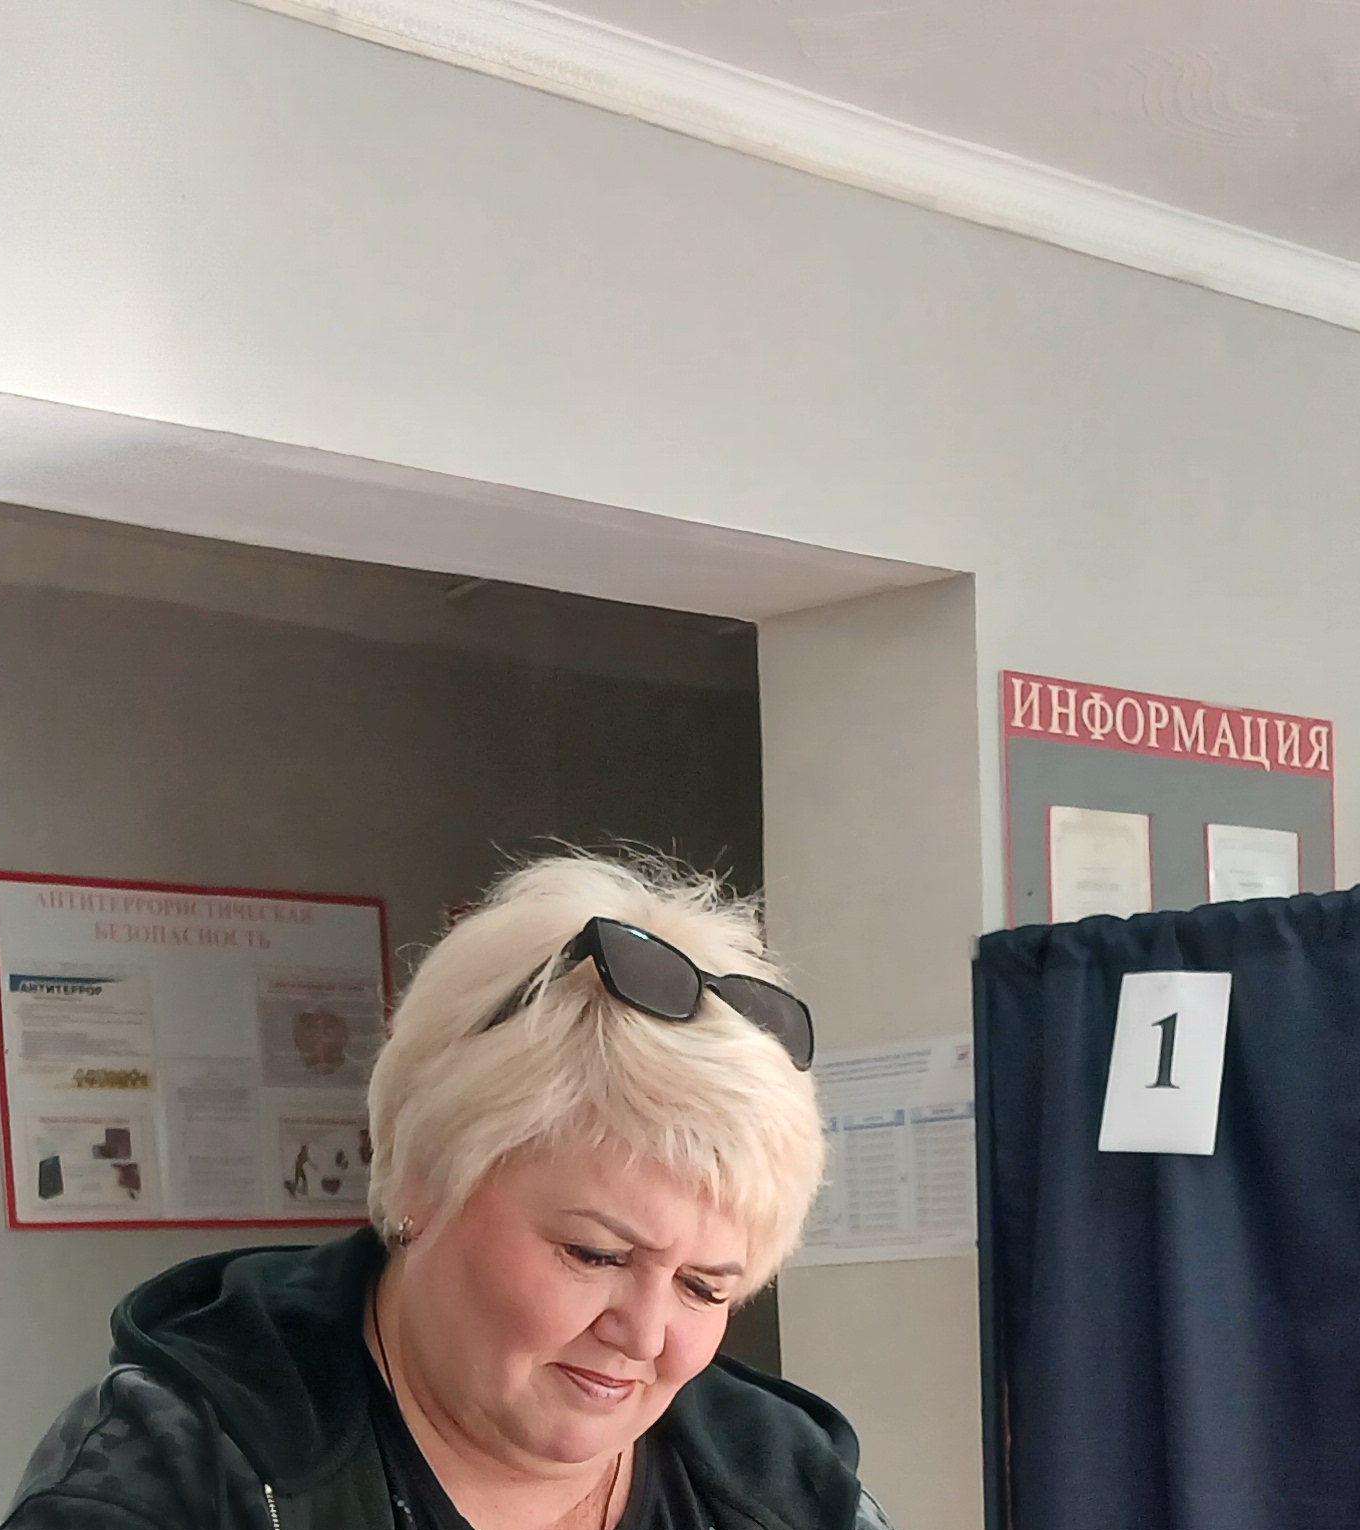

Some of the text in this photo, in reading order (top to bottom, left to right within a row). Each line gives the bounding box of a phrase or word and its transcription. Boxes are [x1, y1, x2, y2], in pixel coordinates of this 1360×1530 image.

[1010, 677, 1331, 772] ИНФОРМАЦИЯ
[94, 921, 273, 949] БЕЗОПАСНОСТЬ
[1144, 1011, 1181, 1090] 1
